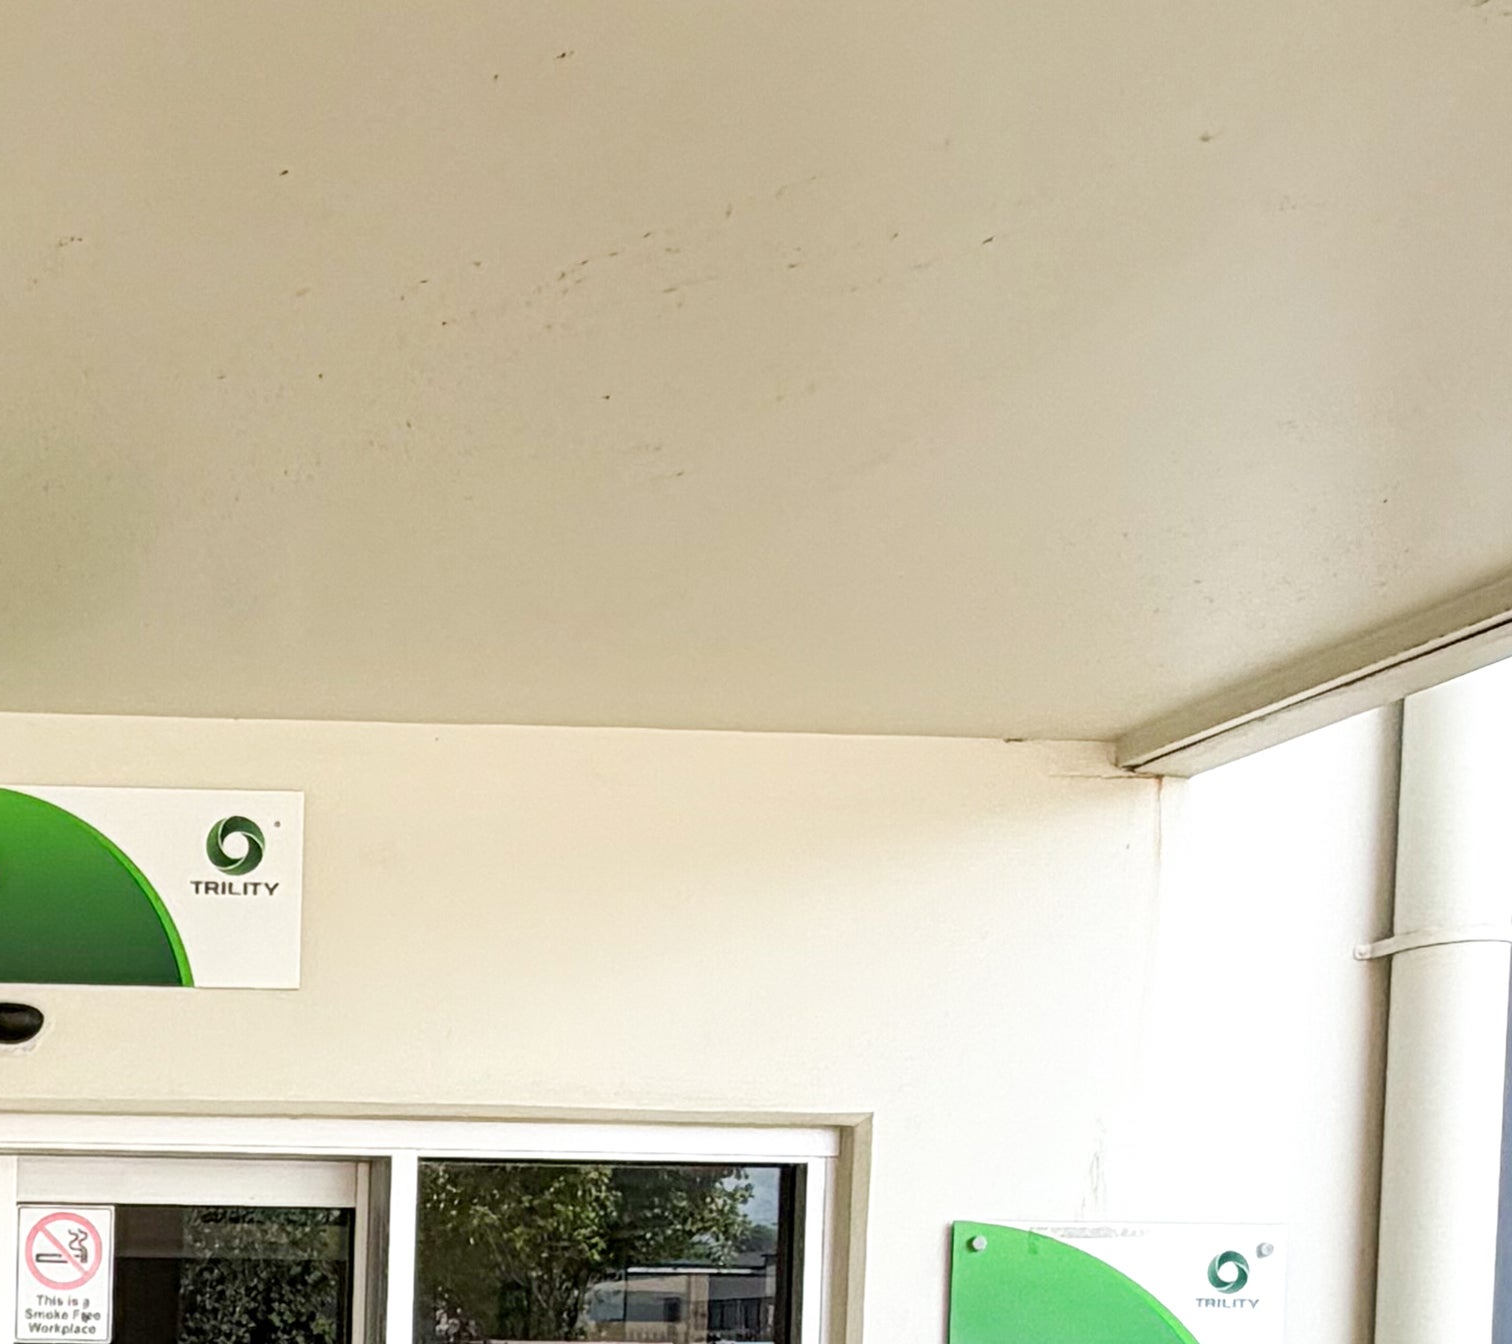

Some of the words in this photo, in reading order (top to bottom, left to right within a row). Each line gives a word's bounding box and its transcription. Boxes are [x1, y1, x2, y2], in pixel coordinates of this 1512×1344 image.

[190, 880, 279, 896] TRILITY
[37, 1294, 64, 1306] This
[68, 1296, 78, 1306] is
[1195, 1297, 1260, 1309] TRILITY
[25, 1308, 68, 1320] Smoke
[28, 1322, 97, 1335] Workplace
